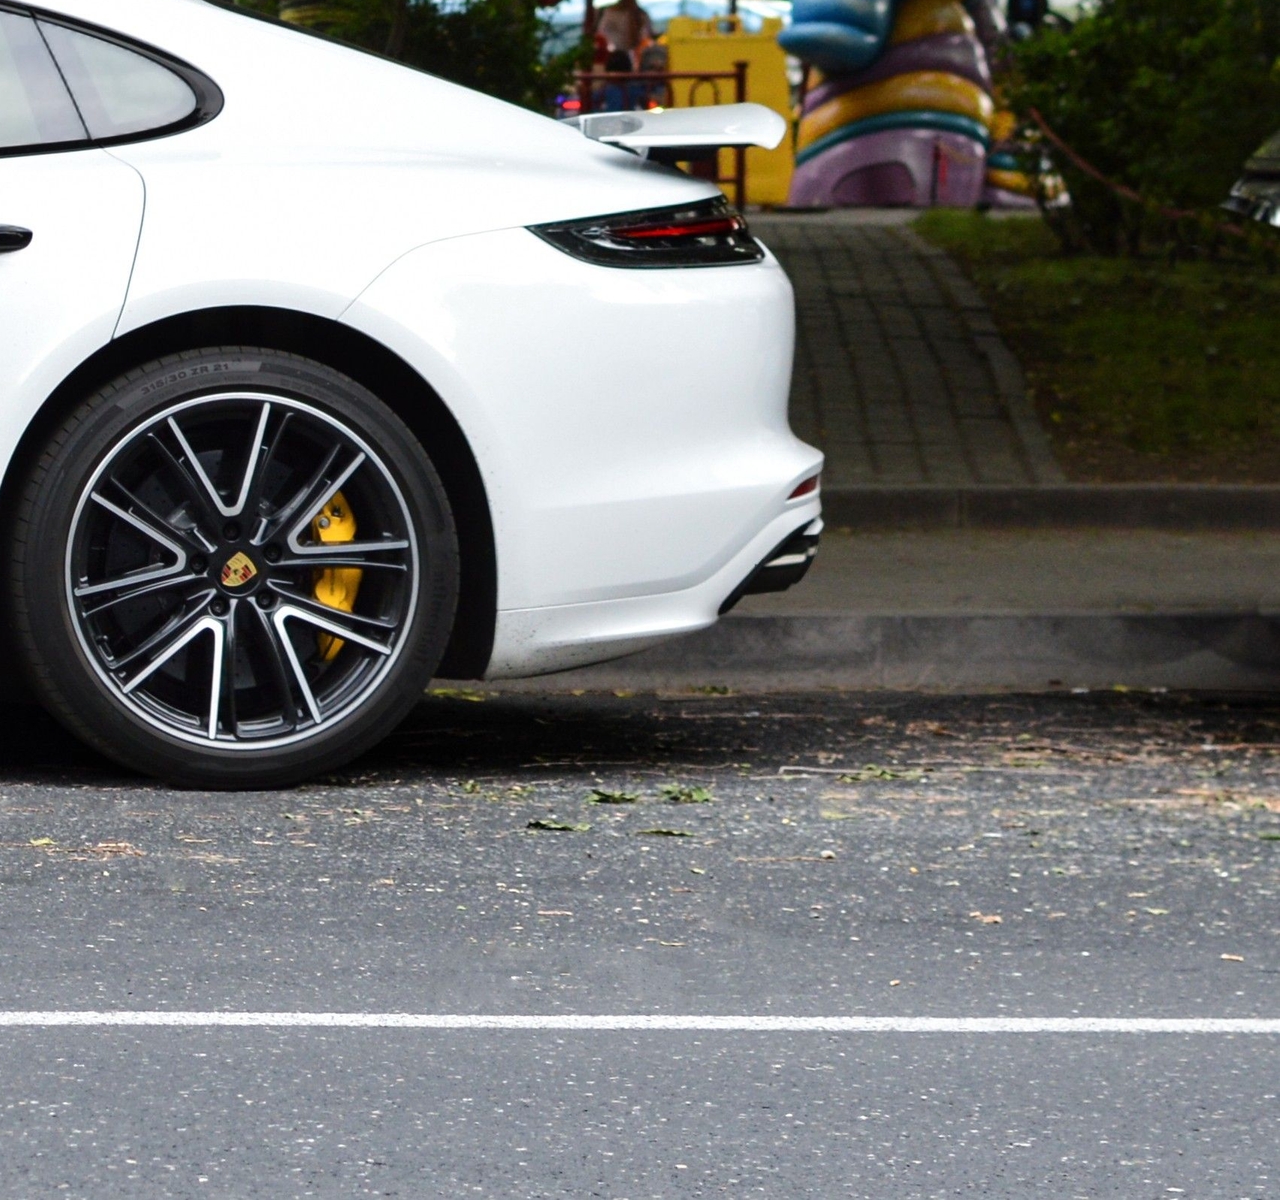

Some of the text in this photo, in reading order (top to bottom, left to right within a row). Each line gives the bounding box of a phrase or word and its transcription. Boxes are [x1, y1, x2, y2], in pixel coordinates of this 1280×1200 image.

[140, 371, 187, 396] 315/30
[190, 365, 210, 376] ZR
[213, 363, 229, 372] 21
